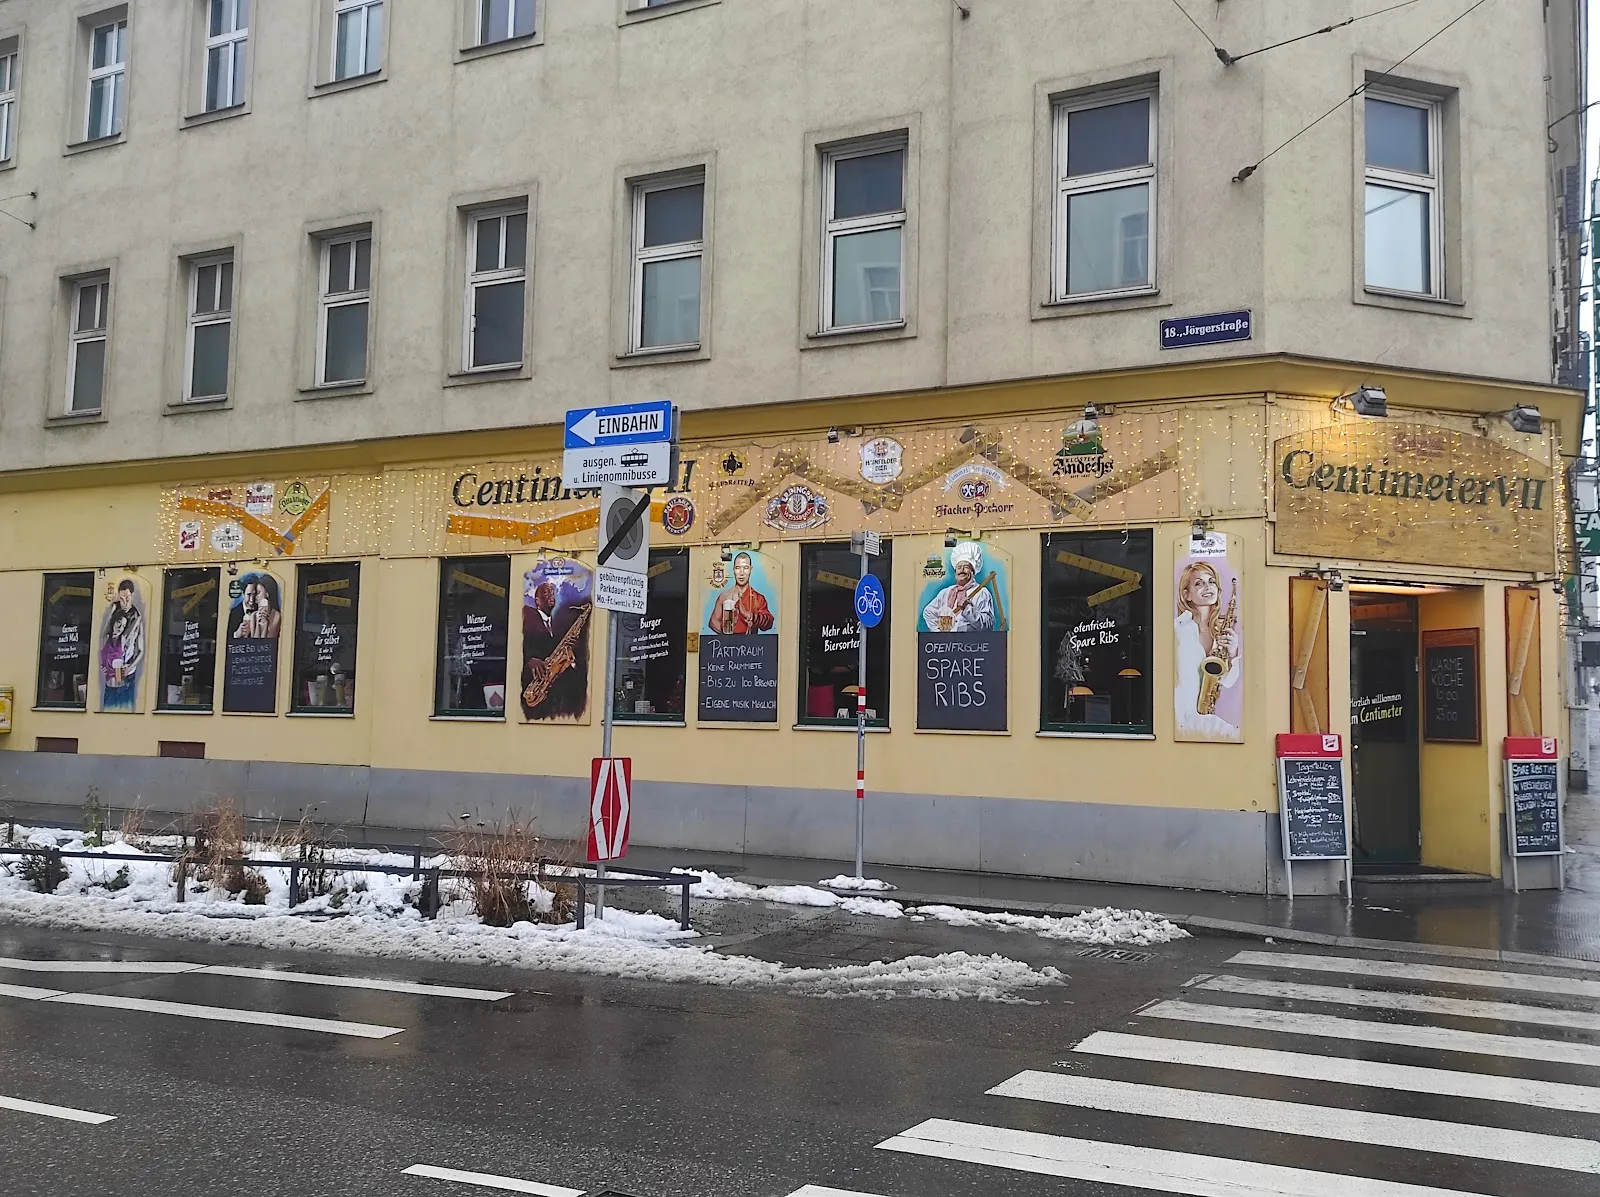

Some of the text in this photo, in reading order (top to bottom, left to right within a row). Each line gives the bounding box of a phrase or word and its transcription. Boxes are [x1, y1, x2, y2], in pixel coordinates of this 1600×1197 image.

[598, 413, 659, 435] EINBAHN
[582, 457, 617, 469] ausgen.
[1052, 455, 1114, 479] Andechs
[582, 469, 657, 483] Linienomnibusse
[599, 572, 644, 589] gebührenpflichtig
[600, 583, 643, 598] Parkdauer: 2 Std.
[466, 613, 487, 624] Wiener
[639, 617, 662, 631] Burger
[1073, 617, 1116, 634] ofenfrische
[821, 624, 840, 638] Mehr
[841, 622, 855, 635] als
[1069, 630, 1119, 652] Spare Ribs
[926, 658, 985, 680] SPARE
[934, 681, 987, 707] RIBS
[1371, 693, 1402, 705] willkommen
[1360, 704, 1404, 723] Centimeter
